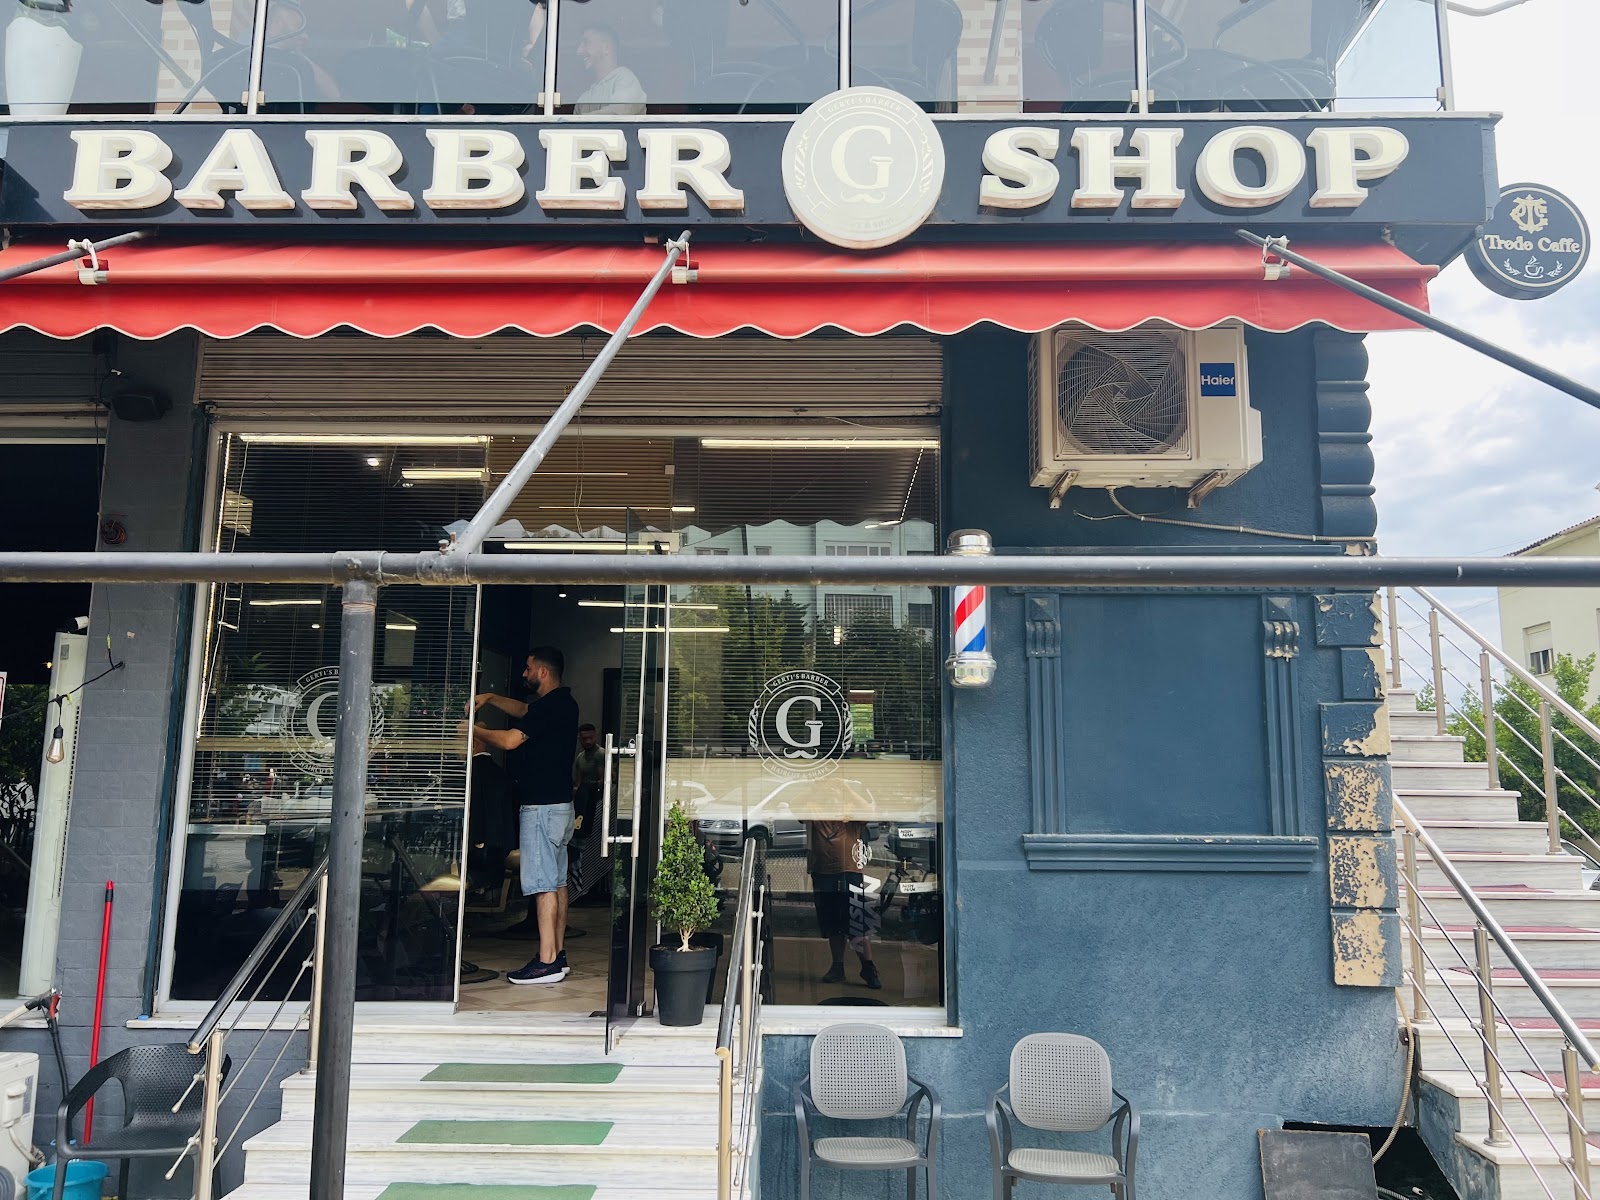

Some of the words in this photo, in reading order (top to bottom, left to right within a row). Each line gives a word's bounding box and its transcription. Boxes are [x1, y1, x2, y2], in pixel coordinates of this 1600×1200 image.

[831, 125, 894, 190] G
[63, 128, 745, 211] BARBER
[979, 125, 1410, 209] SHOP
[1537, 236, 1581, 253] Caffe
[1200, 375, 1235, 386] Haier
[305, 669, 333, 683] GERTI'S
[773, 673, 800, 686] GERTI'S
[801, 673, 829, 686] BARBER
[775, 695, 824, 748] G
